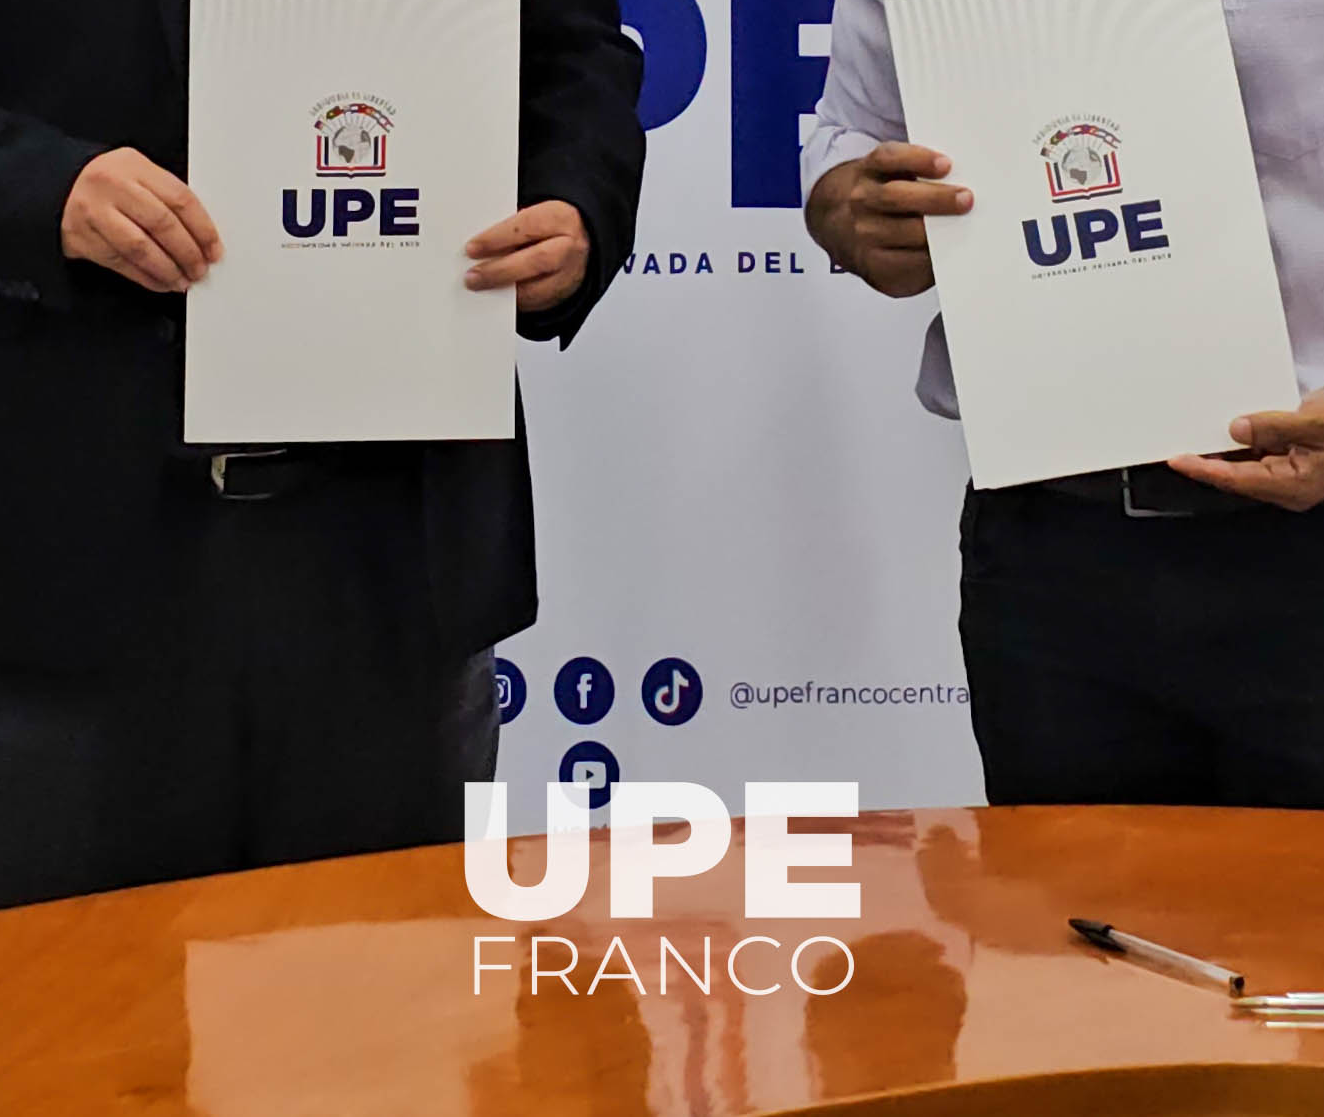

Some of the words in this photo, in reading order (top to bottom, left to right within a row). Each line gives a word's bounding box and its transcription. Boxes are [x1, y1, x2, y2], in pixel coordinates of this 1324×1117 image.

[282, 188, 420, 238] UPE
[1022, 200, 1170, 266] UPE
[737, 251, 805, 274] DEL
[729, 680, 970, 710] @upefrancocentra
